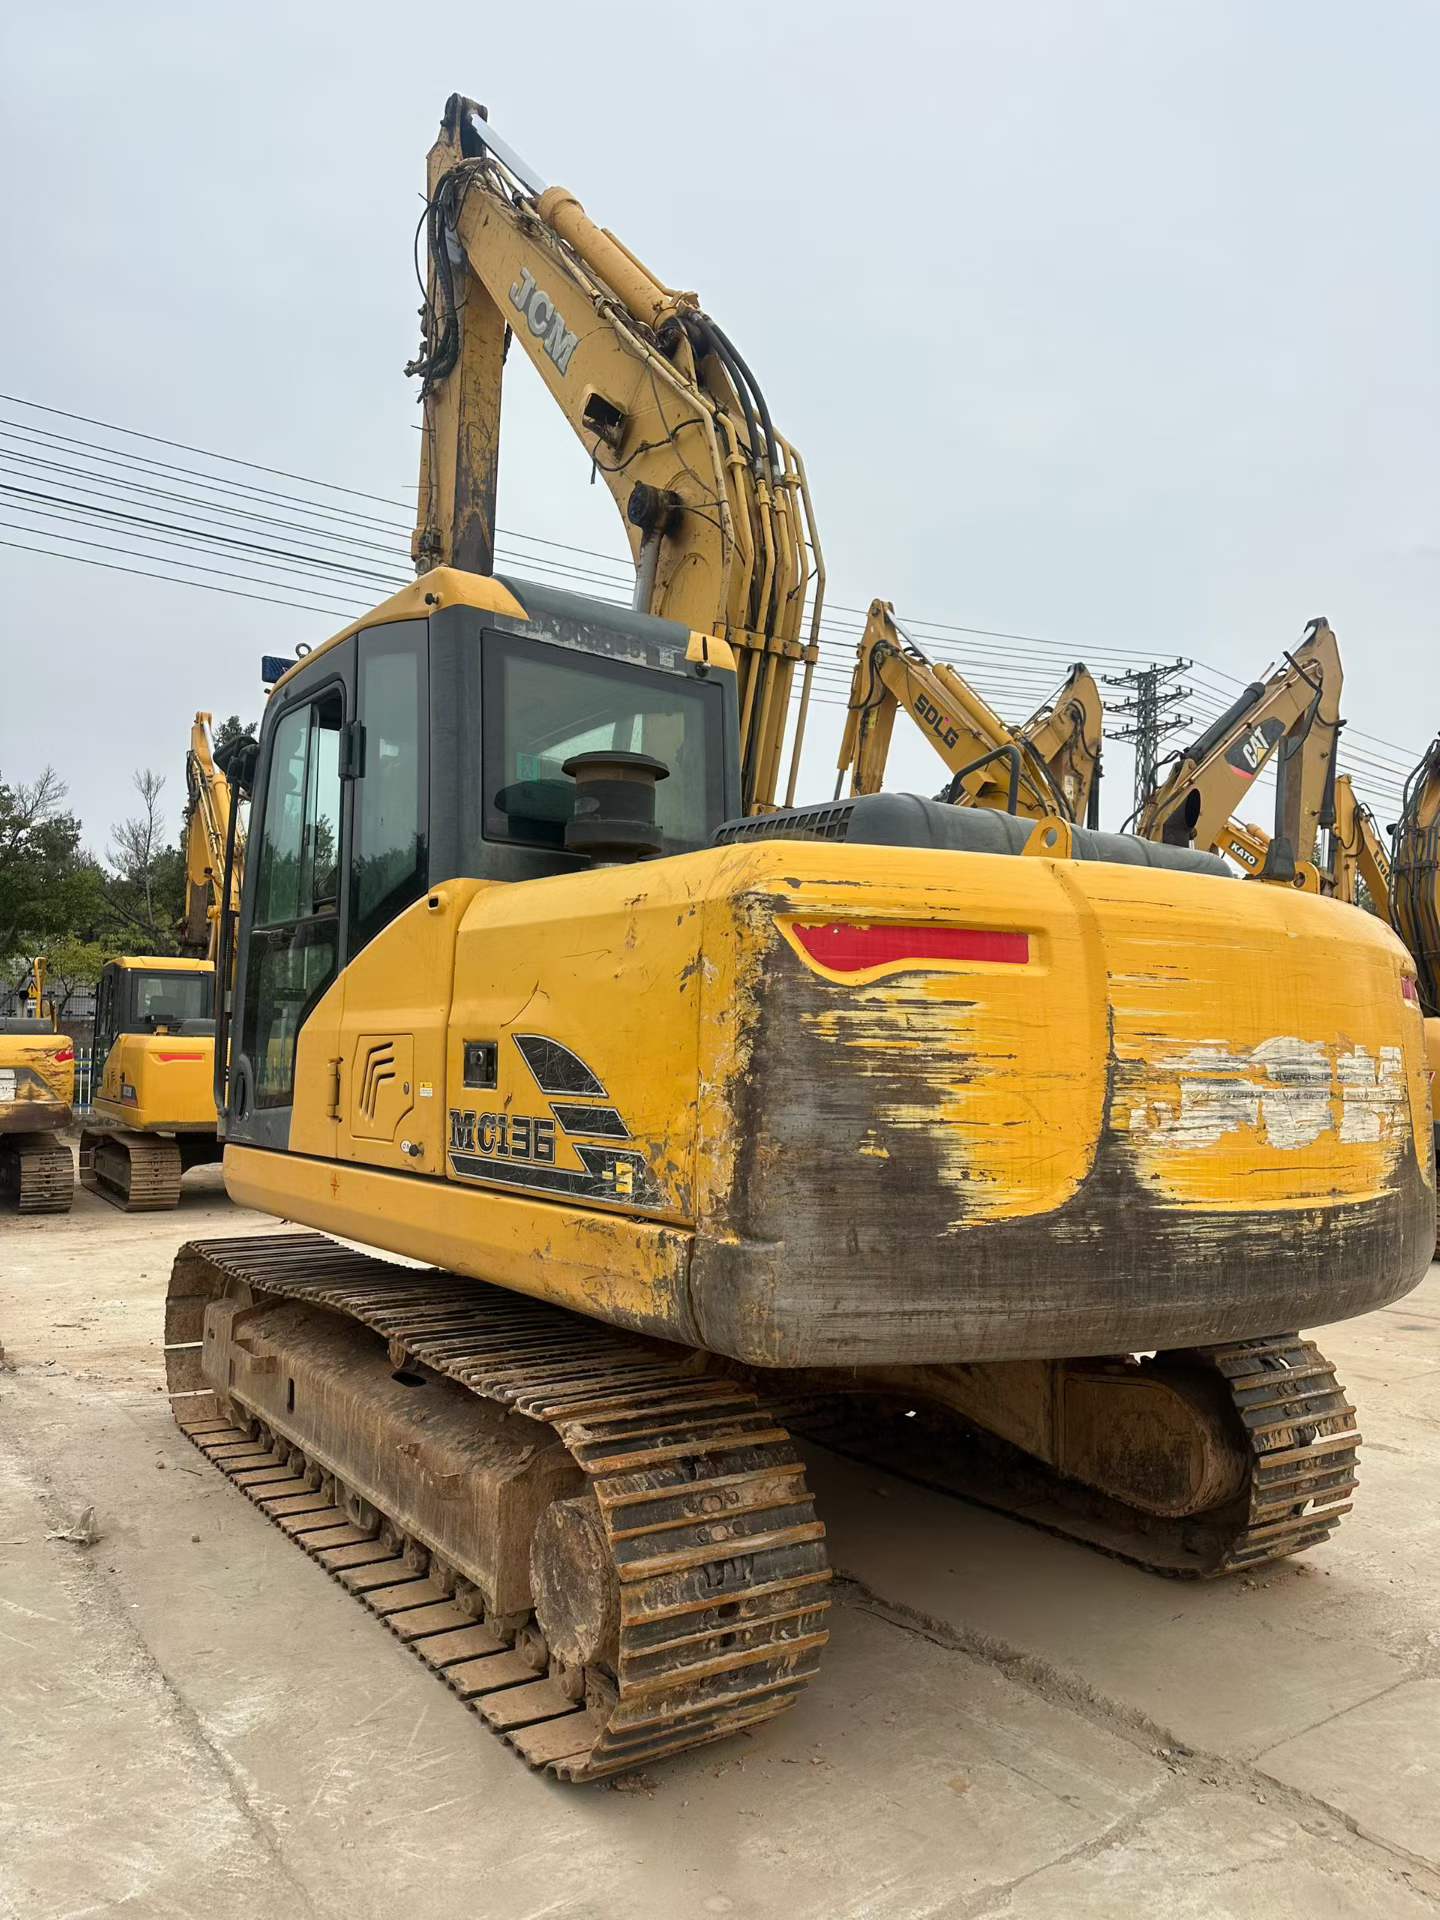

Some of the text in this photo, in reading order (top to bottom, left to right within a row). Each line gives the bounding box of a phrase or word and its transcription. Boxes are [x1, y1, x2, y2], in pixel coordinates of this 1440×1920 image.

[509, 267, 580, 376] JCM
[914, 693, 959, 749] SDLG
[1242, 726, 1270, 769] CAT
[1231, 842, 1256, 865] KATO
